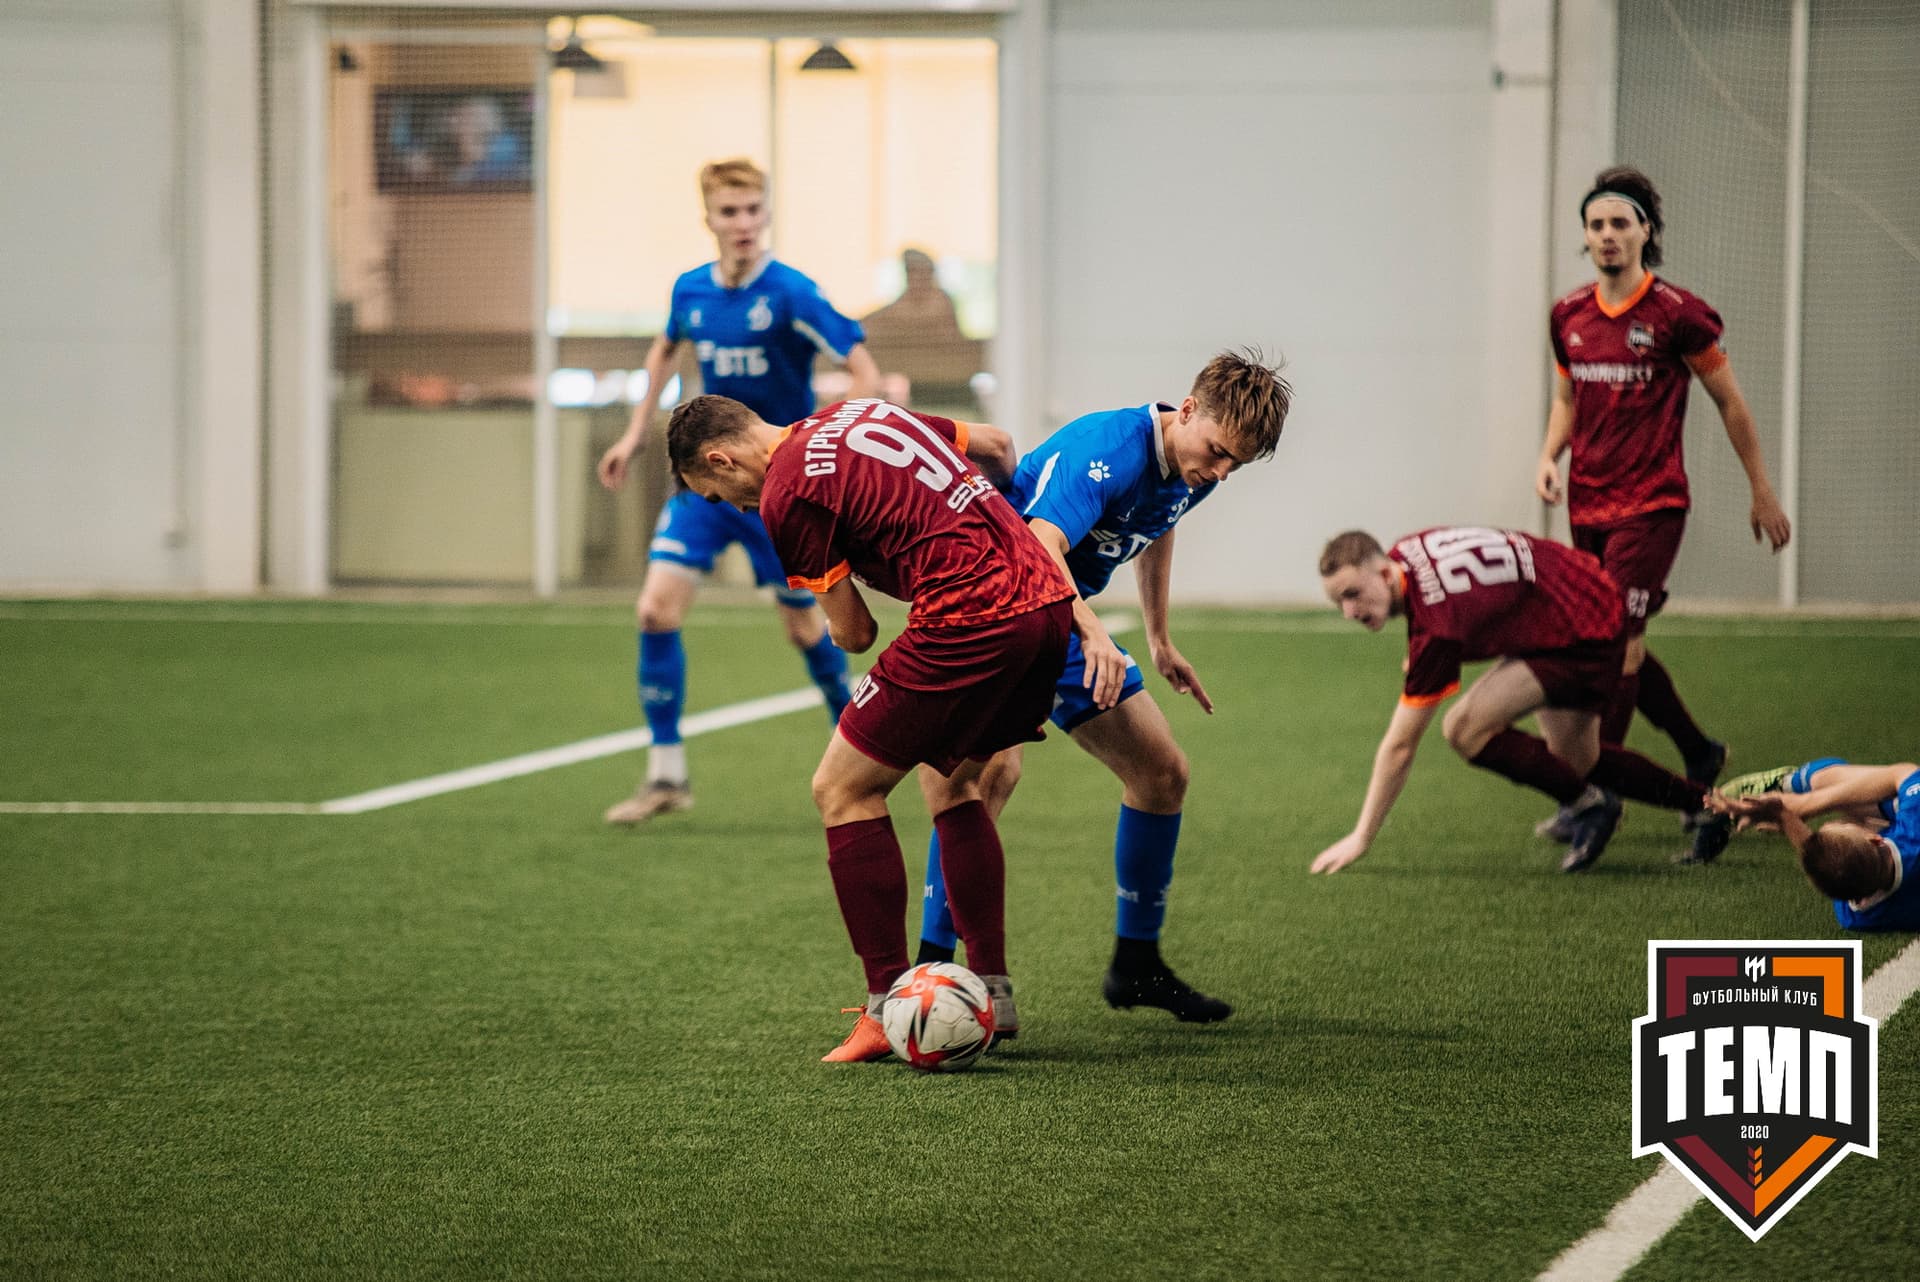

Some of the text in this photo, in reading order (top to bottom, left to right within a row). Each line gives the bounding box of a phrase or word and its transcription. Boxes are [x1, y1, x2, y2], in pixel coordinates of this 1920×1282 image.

[714, 346, 769, 377] ВТБ
[846, 403, 968, 492] 97
[1097, 533, 1154, 562] ВТ
[852, 674, 880, 709] 97
